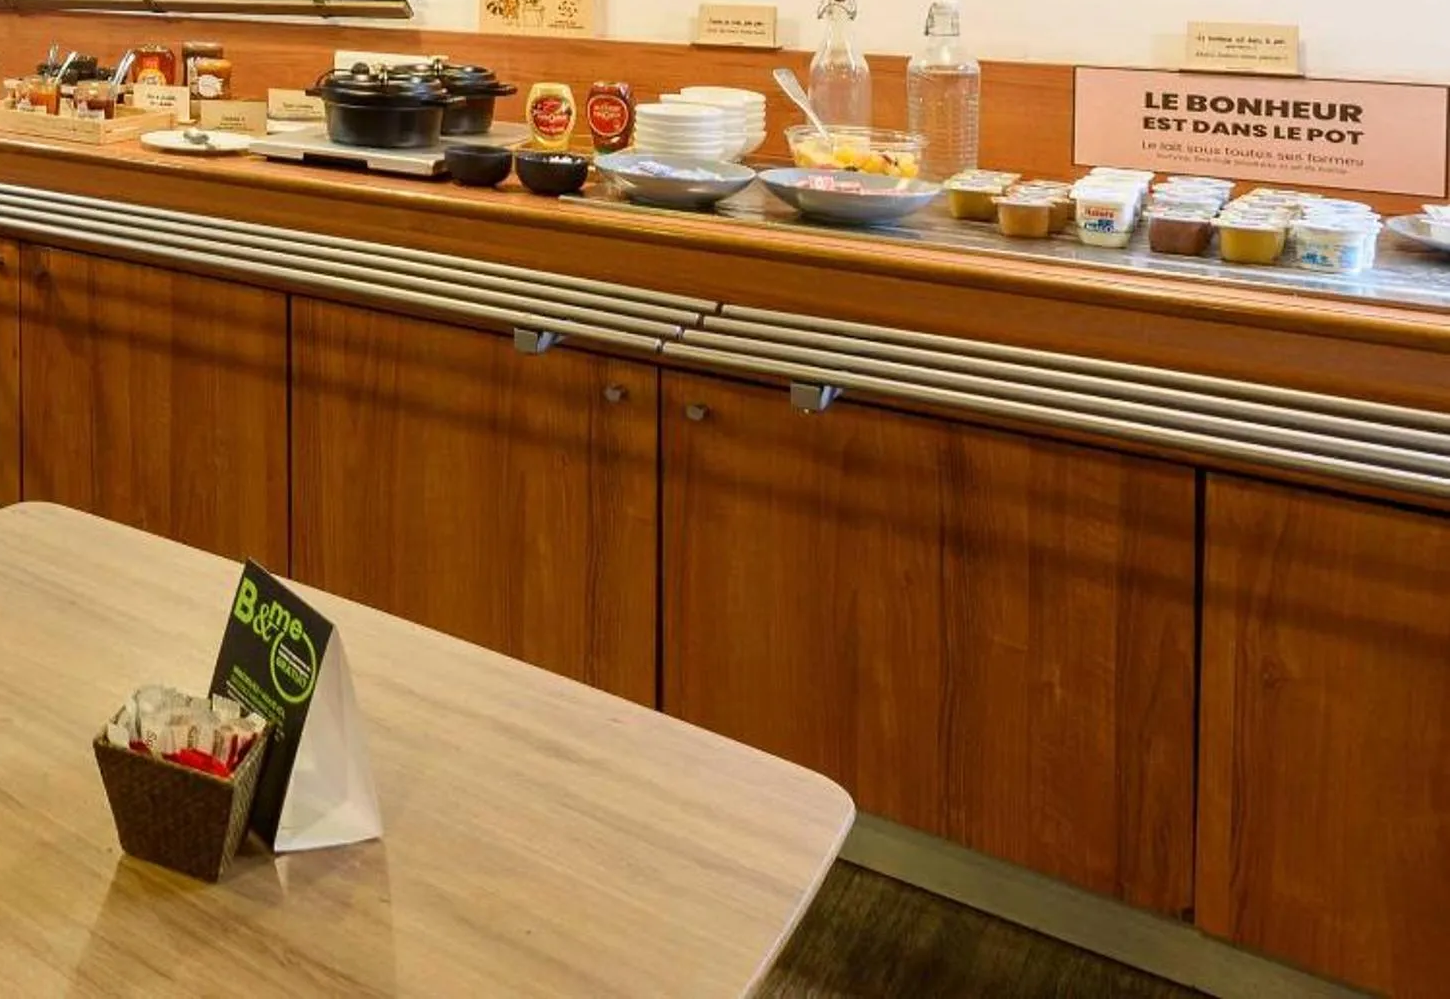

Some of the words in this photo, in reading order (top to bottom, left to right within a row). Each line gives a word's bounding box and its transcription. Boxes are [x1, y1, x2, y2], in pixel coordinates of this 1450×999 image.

[1145, 91, 1178, 111] LE
[1186, 94, 1363, 123] BONHEUR
[1143, 116, 1187, 132] EST
[1192, 121, 1267, 138] DANS
[1273, 125, 1301, 140] LE
[1307, 128, 1365, 145] POT
